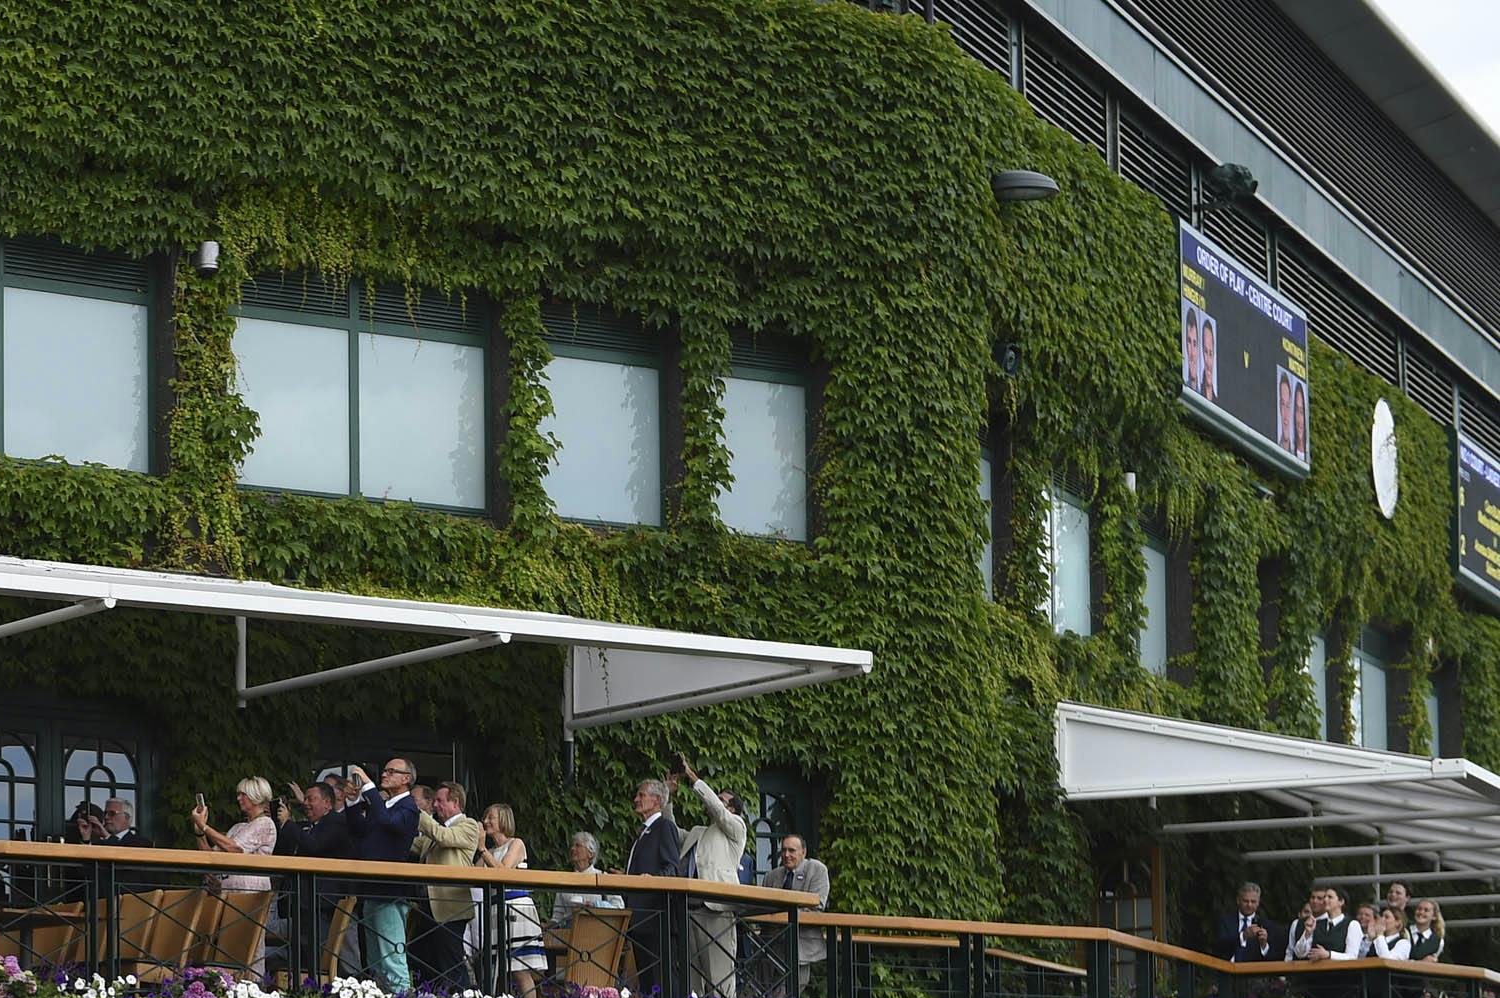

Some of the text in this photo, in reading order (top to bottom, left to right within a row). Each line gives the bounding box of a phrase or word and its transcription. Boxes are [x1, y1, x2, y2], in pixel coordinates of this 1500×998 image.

[1196, 245, 1220, 279] ORDER
[1220, 262, 1230, 284] OF
[1229, 269, 1246, 297] PLAY
[1248, 284, 1273, 318] CENTRE
[1272, 302, 1293, 332] COURT
